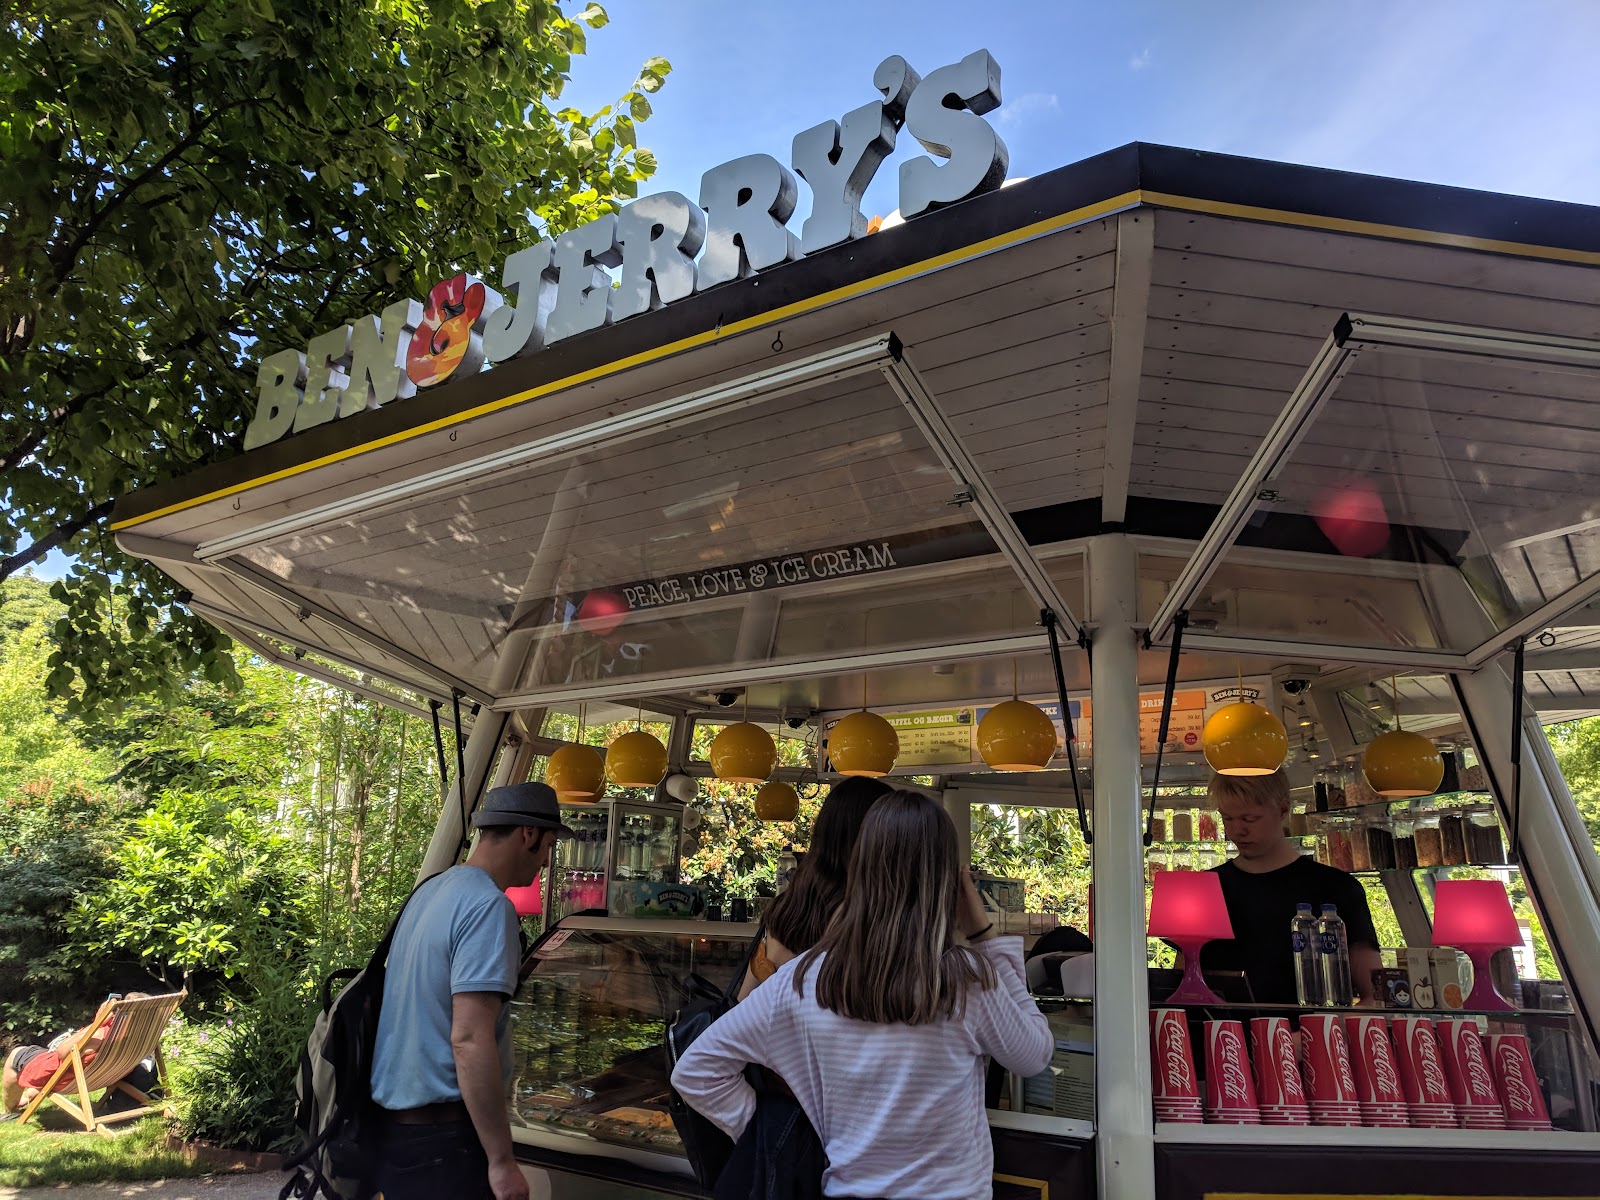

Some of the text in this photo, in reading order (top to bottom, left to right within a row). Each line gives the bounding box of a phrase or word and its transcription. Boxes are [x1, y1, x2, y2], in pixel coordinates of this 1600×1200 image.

[243, 47, 1008, 451] BEN & JERRY'S
[623, 542, 897, 610] PEACE, LOVE & ICE CREAM
[913, 717, 925, 725] OG
